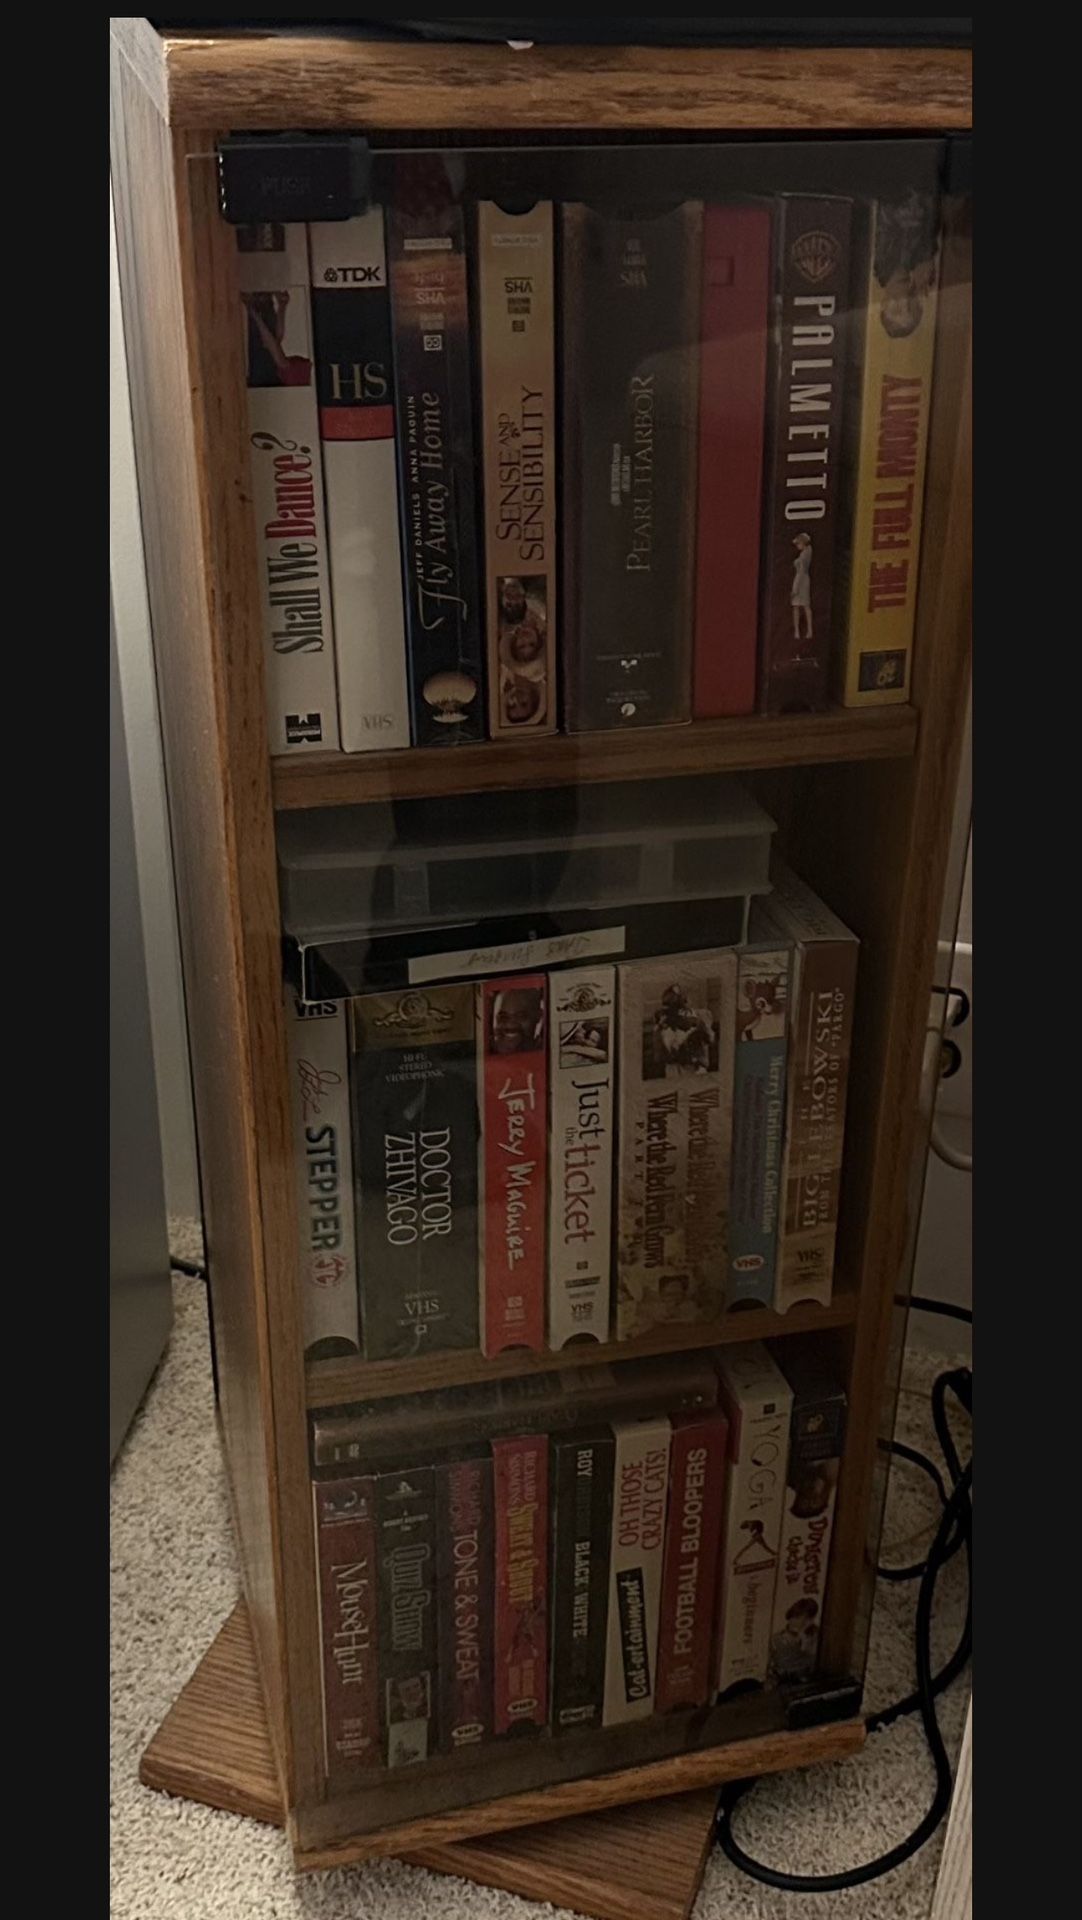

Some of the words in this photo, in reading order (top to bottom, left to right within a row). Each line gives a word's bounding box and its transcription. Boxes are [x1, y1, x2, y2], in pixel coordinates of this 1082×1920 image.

[338, 266, 381, 282] TDK
[416, 291, 446, 305] VHS
[504, 279, 533, 293] VHS
[329, 360, 388, 400] HS
[784, 295, 836, 521] PALMETTO
[407, 395, 418, 444] PAQUIN
[418, 391, 445, 471] Home
[498, 412, 511, 446] AND
[630, 373, 656, 483] HARBOR
[875, 374, 924, 479] MONTY
[251, 430, 317, 538] Dance?
[409, 450, 420, 484] ANNA
[495, 449, 521, 541] SENSE
[519, 386, 545, 562] SENSIBILITY
[411, 492, 423, 547] DANIELS
[422, 480, 450, 555] Away
[625, 489, 653, 573] PEARL
[872, 482, 915, 551] FULL
[266, 542, 319, 585] We
[415, 552, 427, 579] JEFF
[867, 558, 909, 614] THE
[270, 586, 324, 655] Shall
[416, 561, 468, 631] Fly
[363, 713, 393, 730] VHS
[295, 1000, 338, 1018] VHS
[763, 1055, 783, 1096] Merry
[806, 991, 834, 1162] LEBOWSKI
[564, 1126, 578, 1146] the
[571, 1077, 610, 1140] Just
[646, 1090, 679, 1141] Where
[687, 1087, 721, 1137] Where
[765, 1099, 782, 1170] Christmas
[634, 1121, 645, 1181] PART
[645, 1140, 677, 1164] the
[645, 1164, 677, 1194] Red
[305, 1125, 342, 1251] STEPPER
[384, 1131, 419, 1246] ZHIVAGO
[418, 1126, 453, 1241] DOCTOR
[563, 1143, 600, 1246] ticket
[644, 1193, 677, 1225] Fern
[761, 1169, 778, 1235] Collection
[802, 1174, 820, 1227] BIG
[643, 1225, 675, 1269] Grows
[735, 1257, 762, 1269] VHS
[404, 1299, 440, 1316] VHS
[523, 1450, 538, 1502] RICHARD
[576, 1448, 593, 1478] ROY
[619, 1459, 644, 1518] THOSE
[643, 1448, 668, 1495] CATS!
[747, 1424, 782, 1512] YOGA
[447, 1469, 462, 1533] SIMMONS
[469, 1469, 481, 1528] RICHARD
[640, 1499, 664, 1551] CRAZY
[680, 1447, 708, 1554] BLOOPERS
[453, 1529, 480, 1590] TONE
[618, 1518, 640, 1547] OH
[573, 1540, 592, 1589] BLACK
[329, 1556, 370, 1685] MouseHunt
[454, 1593, 480, 1611] &
[572, 1591, 590, 1639] WHITE
[673, 1555, 699, 1655] FOOTBALL
[454, 1613, 481, 1681] SWEAT
[619, 1577, 649, 1698] Cat-ertainment
